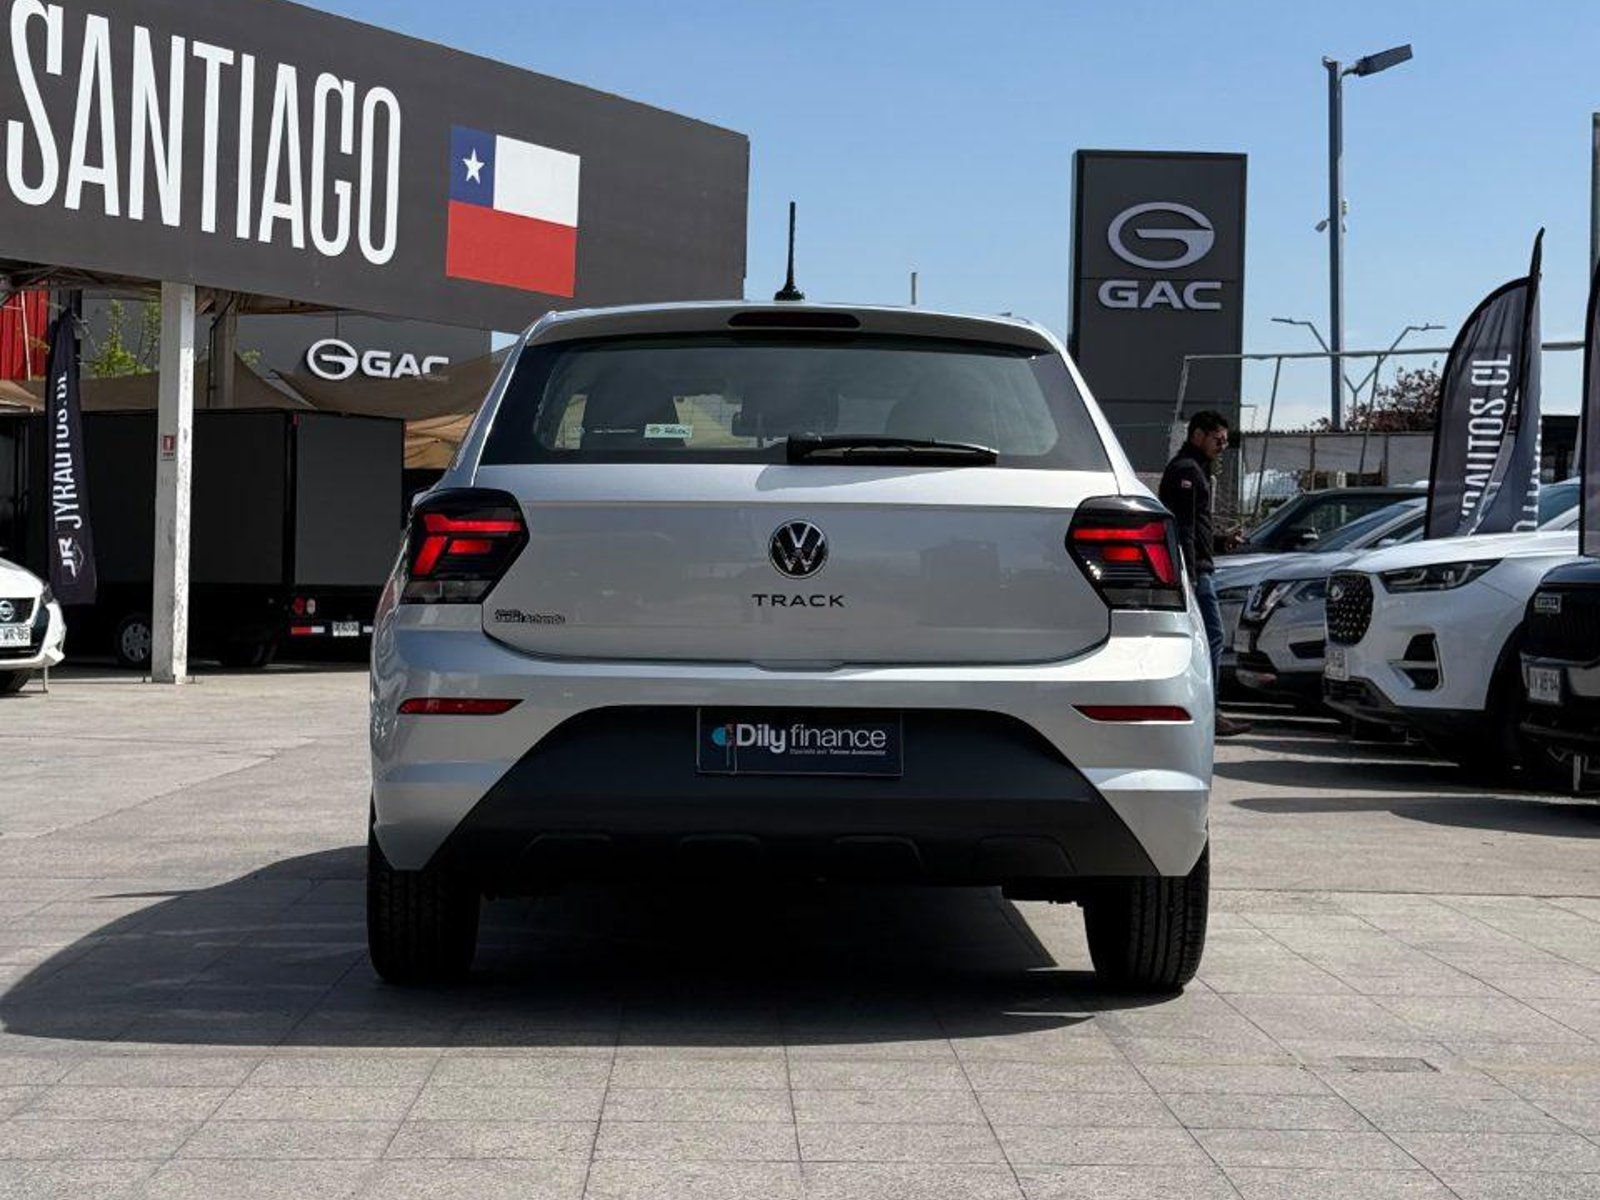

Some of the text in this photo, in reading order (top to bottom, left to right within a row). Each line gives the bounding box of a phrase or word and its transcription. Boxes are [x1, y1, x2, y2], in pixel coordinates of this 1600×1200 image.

[6, 0, 401, 265] SANTIAGO
[1098, 280, 1222, 310] GAC
[752, 594, 845, 608] TRACK
[736, 723, 887, 754] Dily finance
